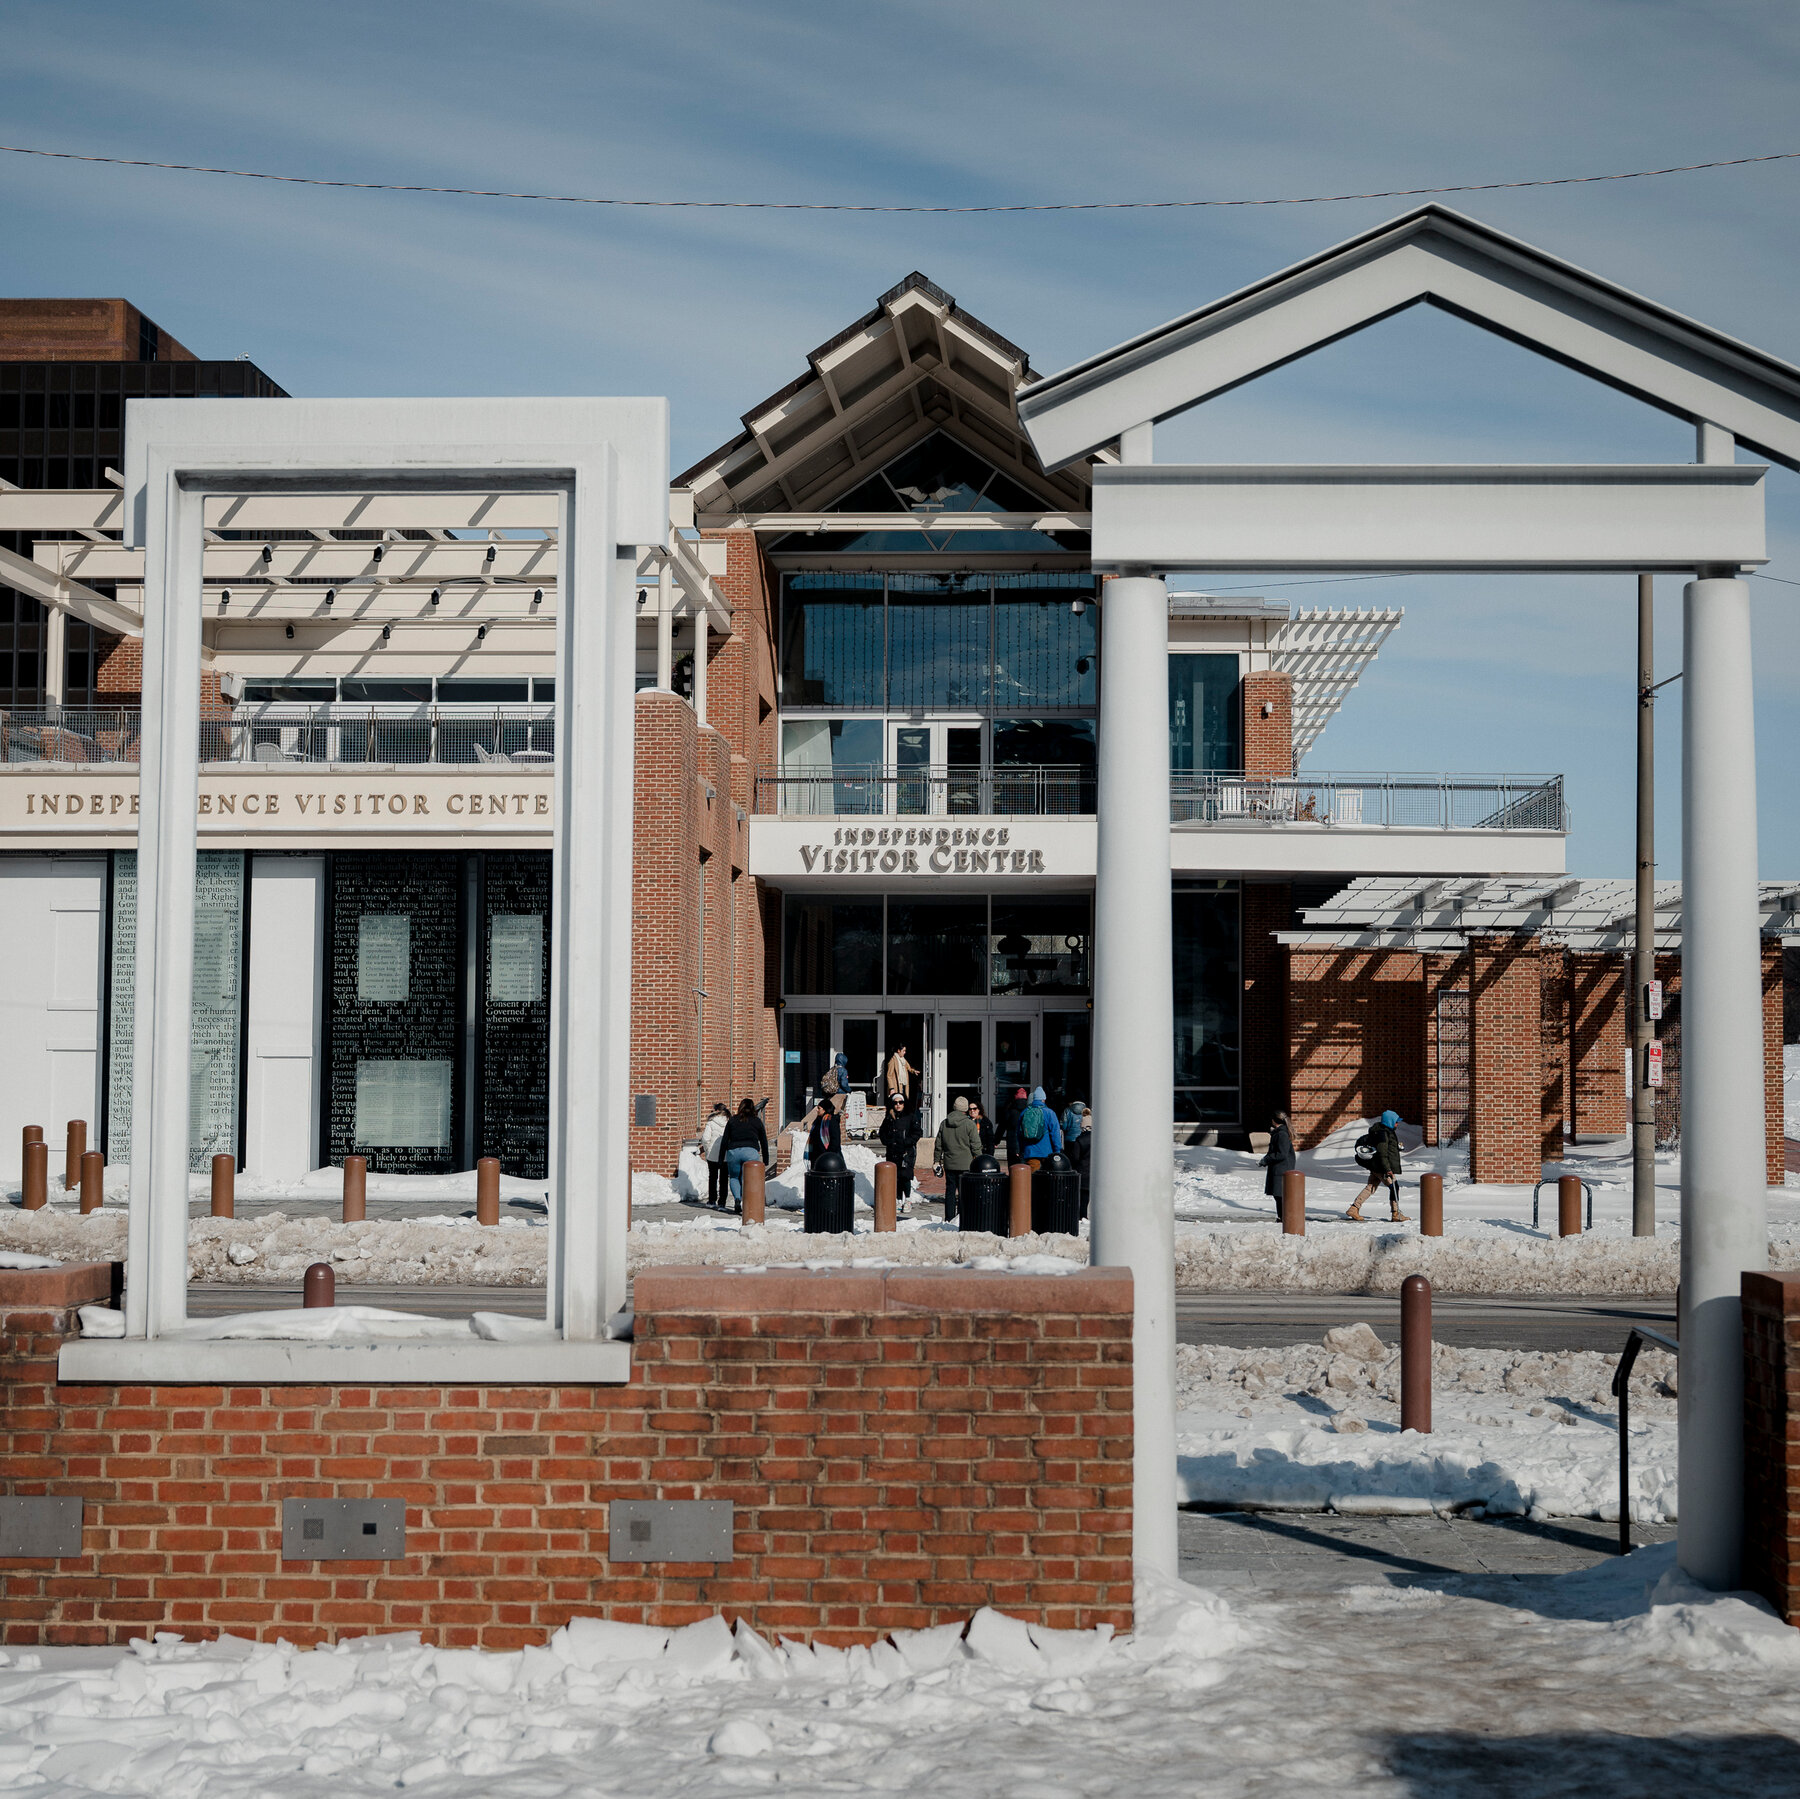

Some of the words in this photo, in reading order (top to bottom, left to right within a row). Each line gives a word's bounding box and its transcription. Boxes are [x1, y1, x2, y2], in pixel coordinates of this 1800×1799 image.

[26, 793, 280, 815] INDEPEENCE
[295, 793, 430, 815] VISITOR
[446, 793, 549, 815] CENTE
[835, 827, 1010, 844] INDEPENDENCE
[799, 844, 919, 871] VISITOR
[931, 844, 1046, 871] CENTER
[338, 999, 351, 1009] We
[354, 999, 373, 1007] hold
[377, 999, 399, 1007] these
[404, 999, 429, 1007] Truths
[433, 999, 442, 1007] to
[445, 999, 455, 1007] be
[485, 1000, 520, 1008] Consent
[522, 1000, 531, 1008] of
[387, 1007, 402, 1015] that
[407, 1007, 417, 1015] all
[421, 1007, 439, 1015] Men
[485, 1007, 528, 1016] Governed,
[530, 1007, 547, 1015] that
[333, 1015, 363, 1023] created
[398, 1015, 413, 1023] that
[419, 1015, 437, 1025] they
[333, 1022, 367, 1031] endowed
[370, 1022, 380, 1033] by
[383, 1022, 401, 1031] their
[404, 1022, 434, 1031] Creator
[437, 1022, 455, 1031] with
[331, 1107, 344, 1115] the
[331, 1138, 346, 1146] and
[331, 1146, 349, 1154] such
[395, 1146, 403, 1154] to
[408, 1146, 429, 1154] them
[376, 1153, 397, 1164] likely
[399, 1153, 408, 1161] to
[410, 1153, 432, 1161] effect
[434, 1153, 453, 1161] their
